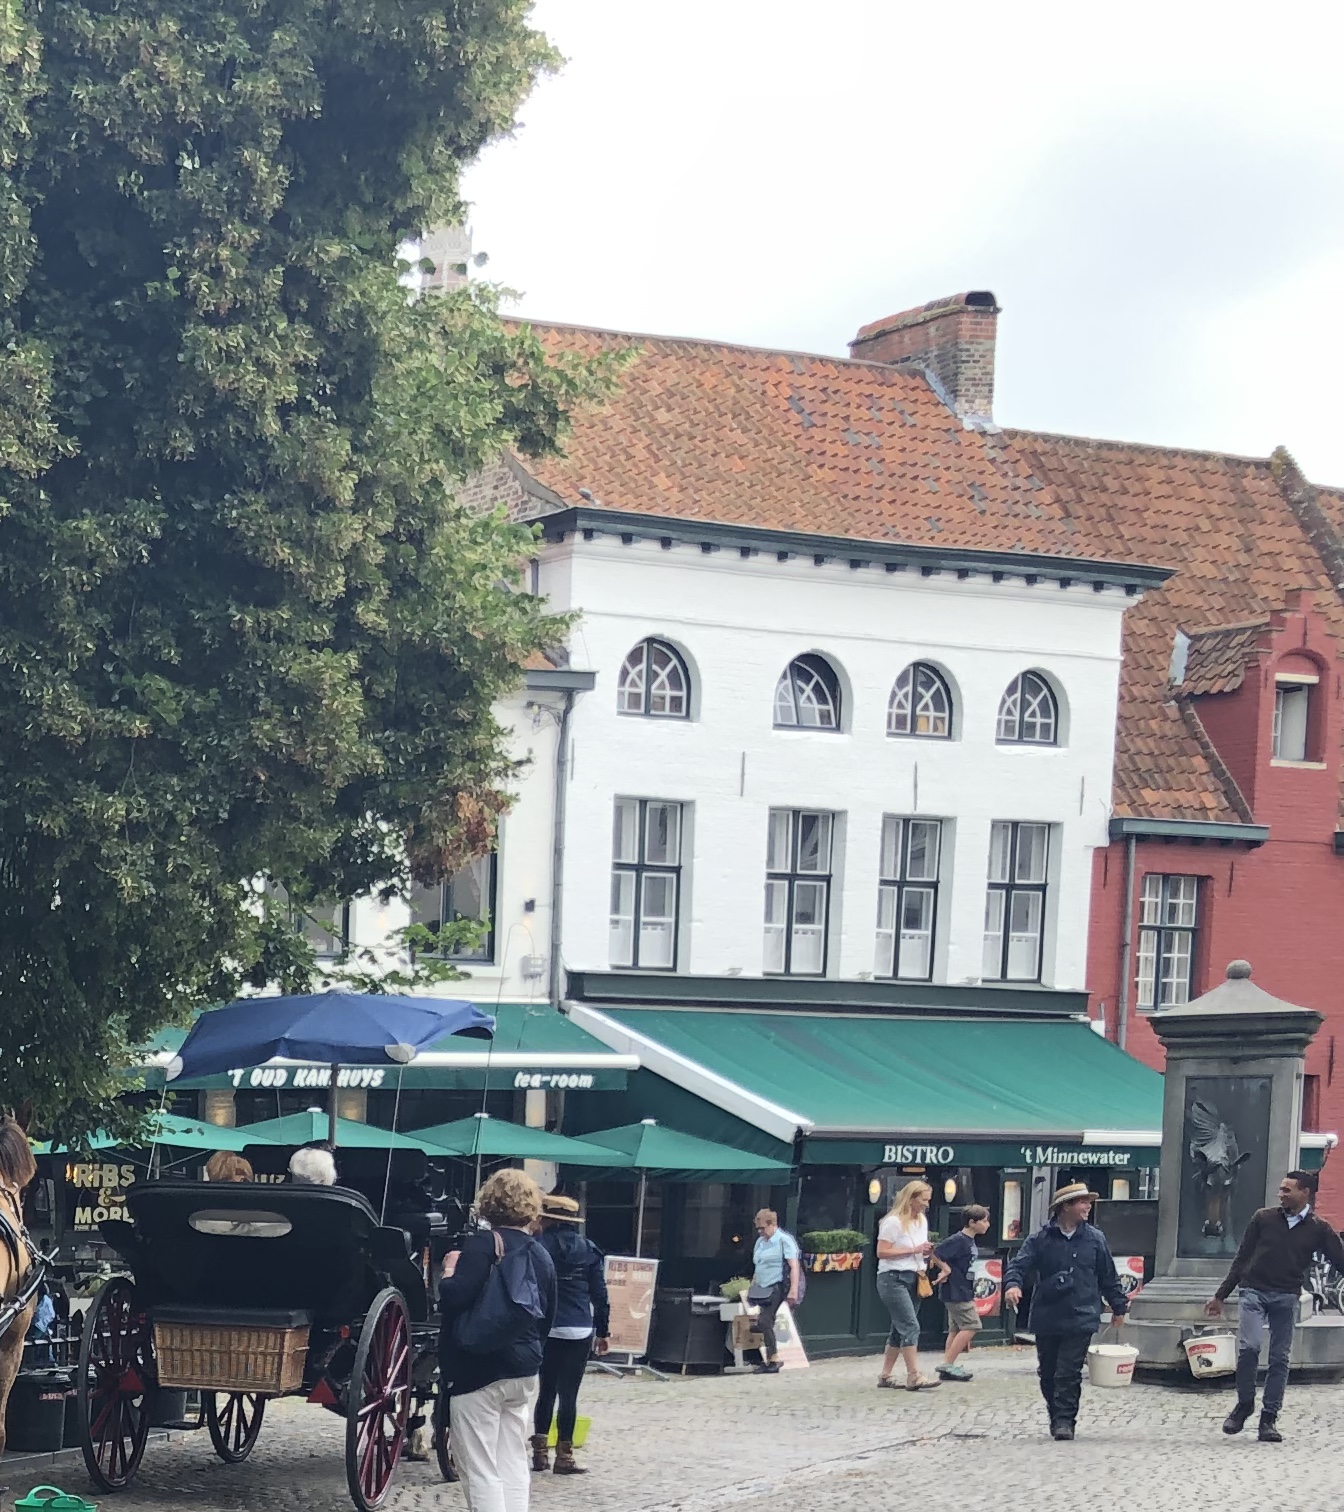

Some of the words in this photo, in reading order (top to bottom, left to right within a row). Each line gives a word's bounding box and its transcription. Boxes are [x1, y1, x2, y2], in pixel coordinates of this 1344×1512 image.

[250, 1068, 288, 1087] OUD
[514, 1071, 593, 1089] tea-room
[882, 1145, 954, 1164] BISTRO
[1035, 1146, 1131, 1165] Minnewater
[97, 1187, 126, 1206] &
